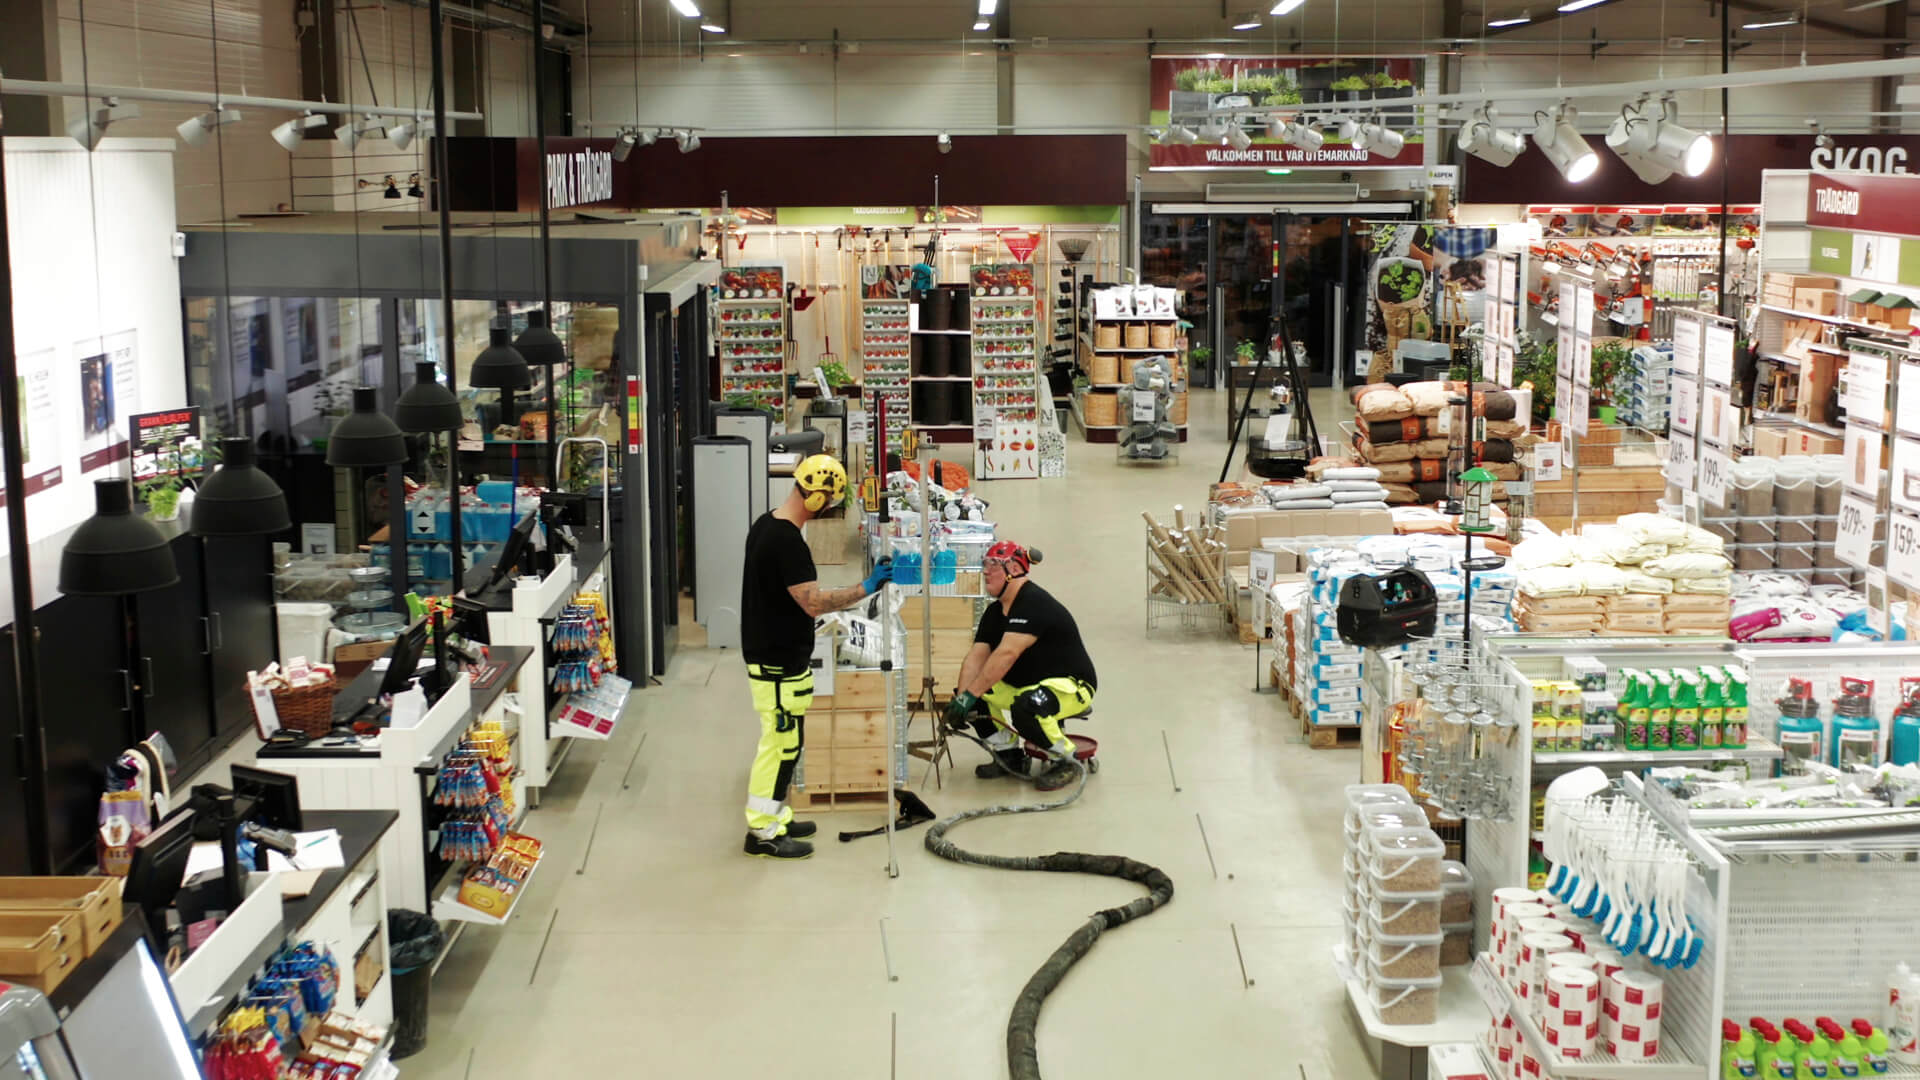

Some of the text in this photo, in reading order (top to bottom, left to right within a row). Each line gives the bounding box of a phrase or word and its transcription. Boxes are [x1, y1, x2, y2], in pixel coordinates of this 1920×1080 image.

[1206, 149, 1263, 162] VÄLKOMMEN
[1265, 150, 1284, 161] TILL
[1305, 150, 1369, 161] UTEMARKNAD
[1810, 146, 1908, 175] SKOG
[547, 153, 568, 210] PARK
[569, 152, 576, 207] &
[1816, 187, 1859, 216] TRÄDGÅRD
[1704, 456, 1724, 488] 199:-
[1841, 504, 1867, 536] 379:-
